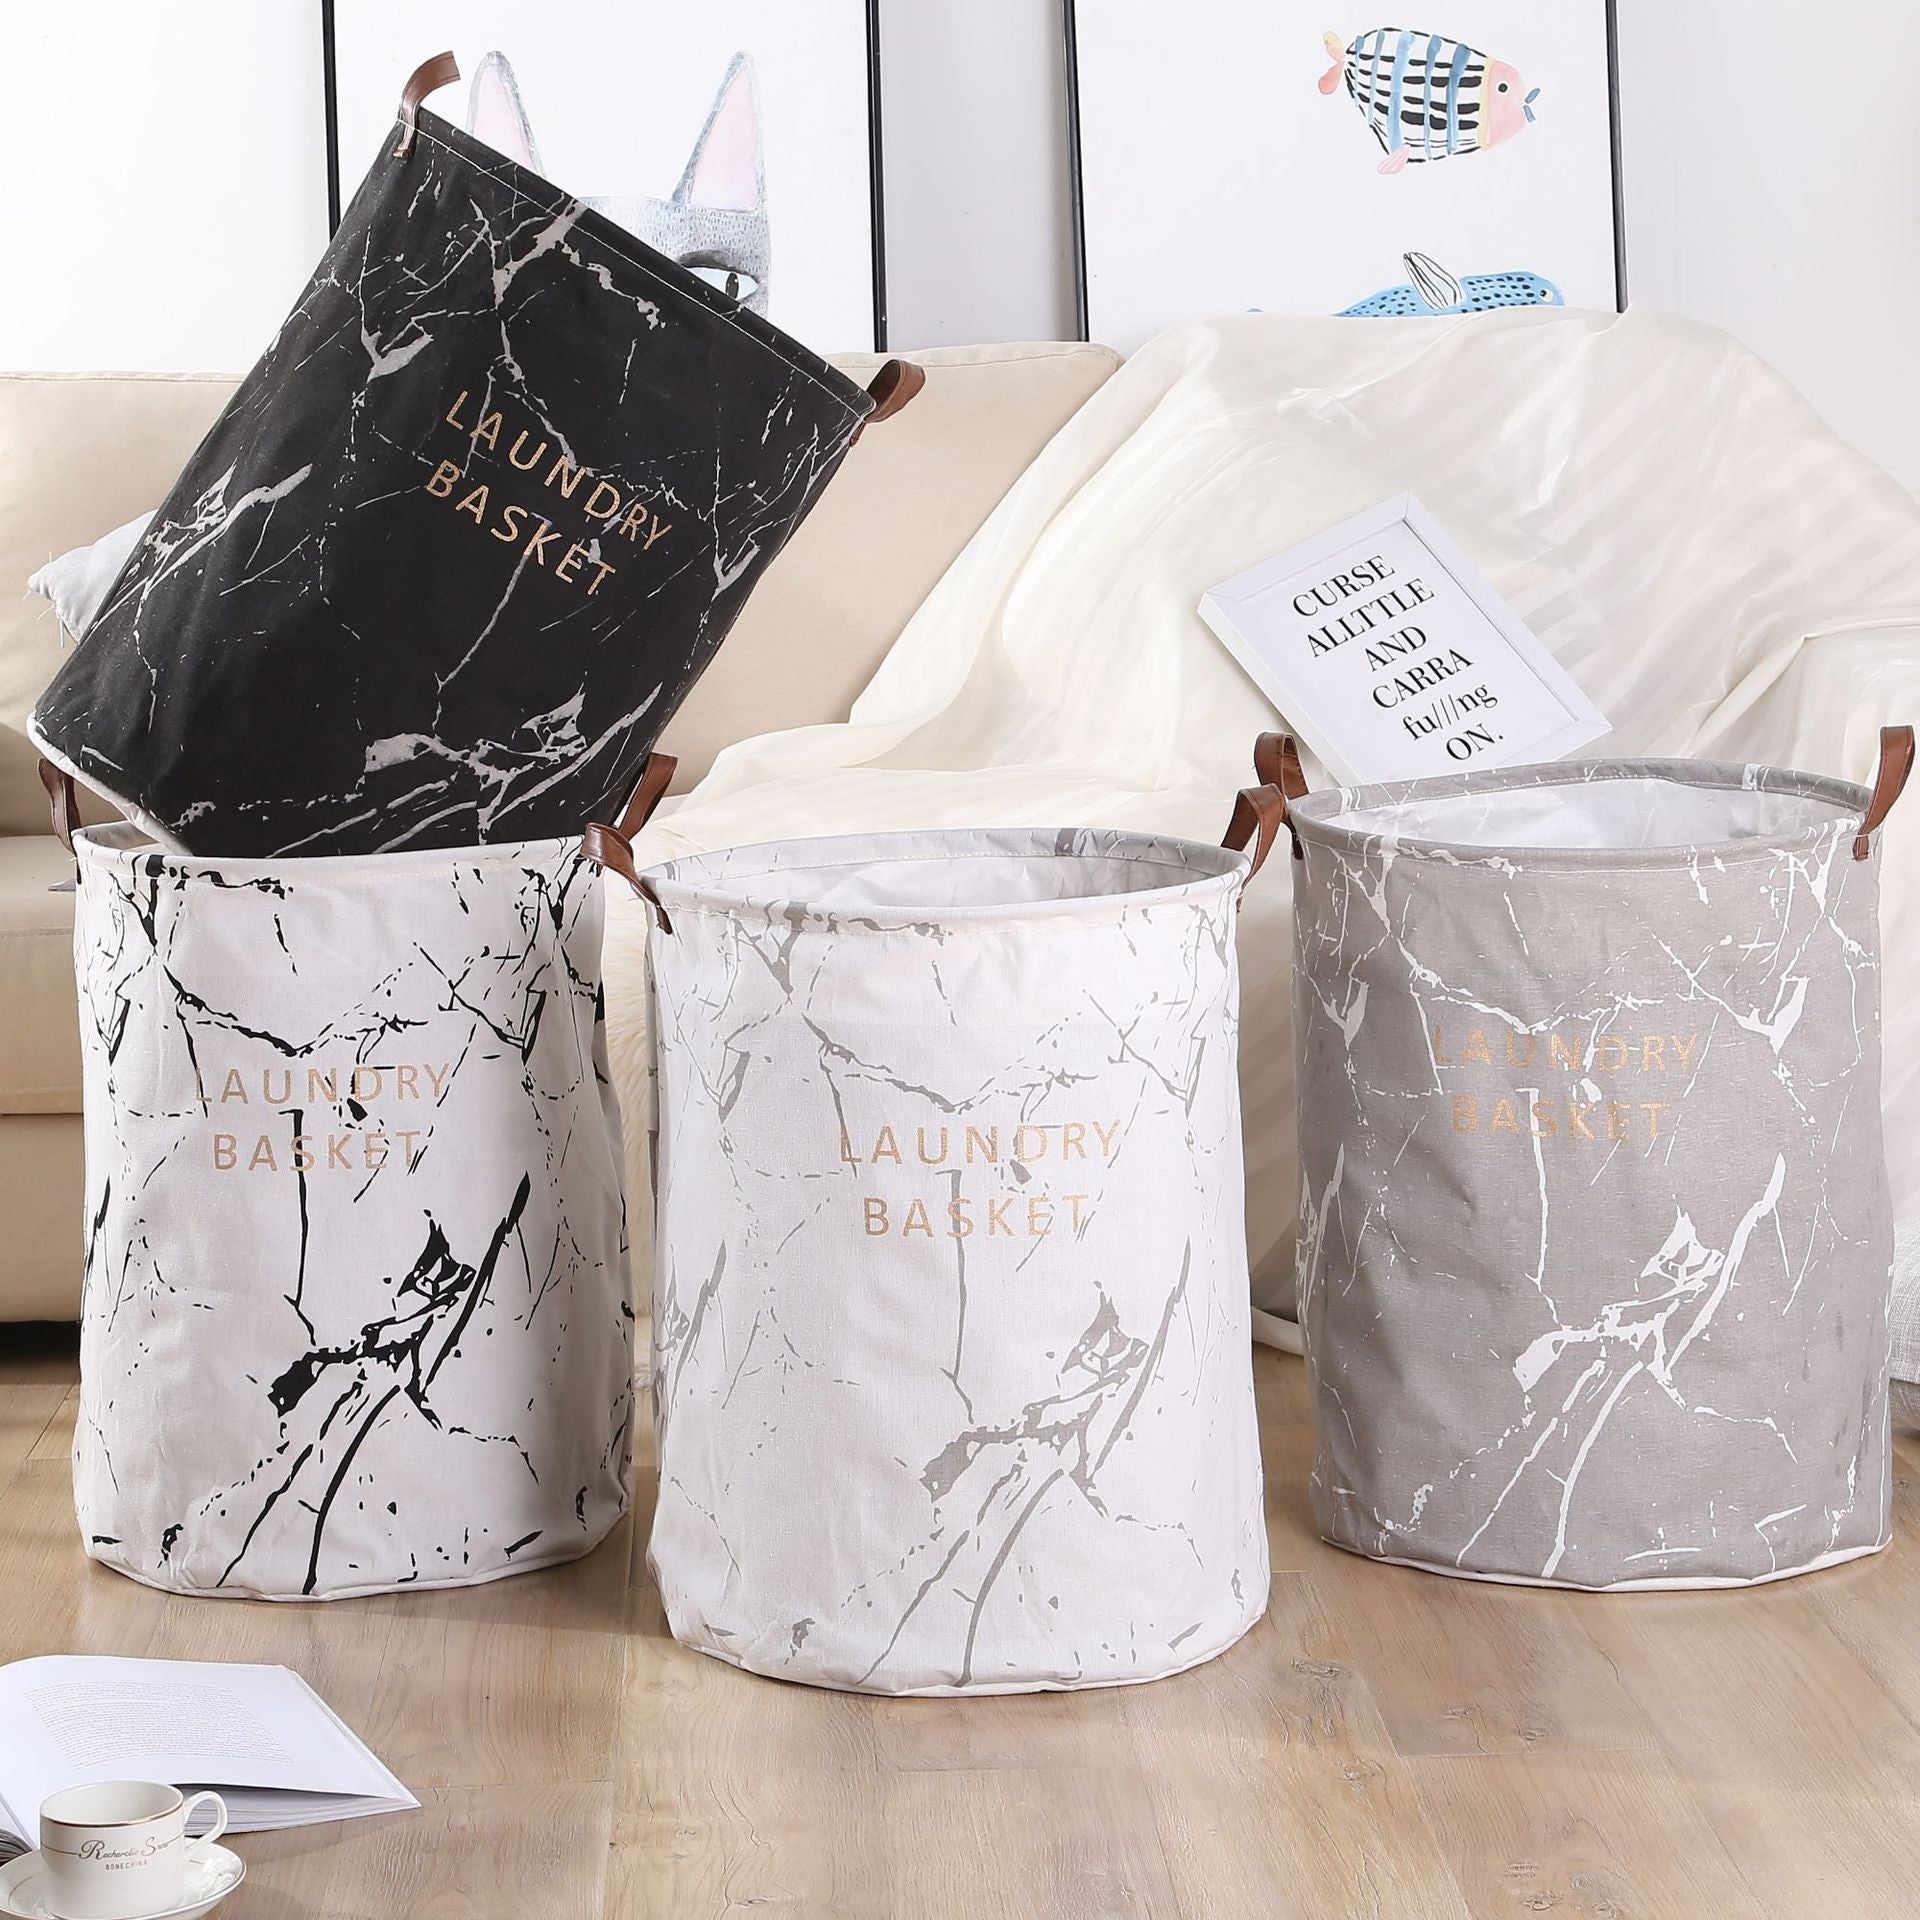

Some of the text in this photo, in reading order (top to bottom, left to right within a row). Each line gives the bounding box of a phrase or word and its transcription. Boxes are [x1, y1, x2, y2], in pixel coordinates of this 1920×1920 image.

[446, 391, 672, 551] LAUNDRY
[426, 459, 616, 595] BASKET
[1292, 555, 1396, 617] CURSE
[1364, 625, 1428, 672] AND
[1372, 648, 1474, 709] CARRA
[1446, 723, 1504, 762] ON.
[1434, 1025, 1697, 1073] LAUNDRY
[195, 1062, 450, 1105] LAUNDRY
[1453, 1095, 1670, 1140] BASKET
[213, 1130, 421, 1172] BASKET
[839, 1119, 1121, 1165] LAUNDRY
[863, 1193, 1089, 1238] BASKET
